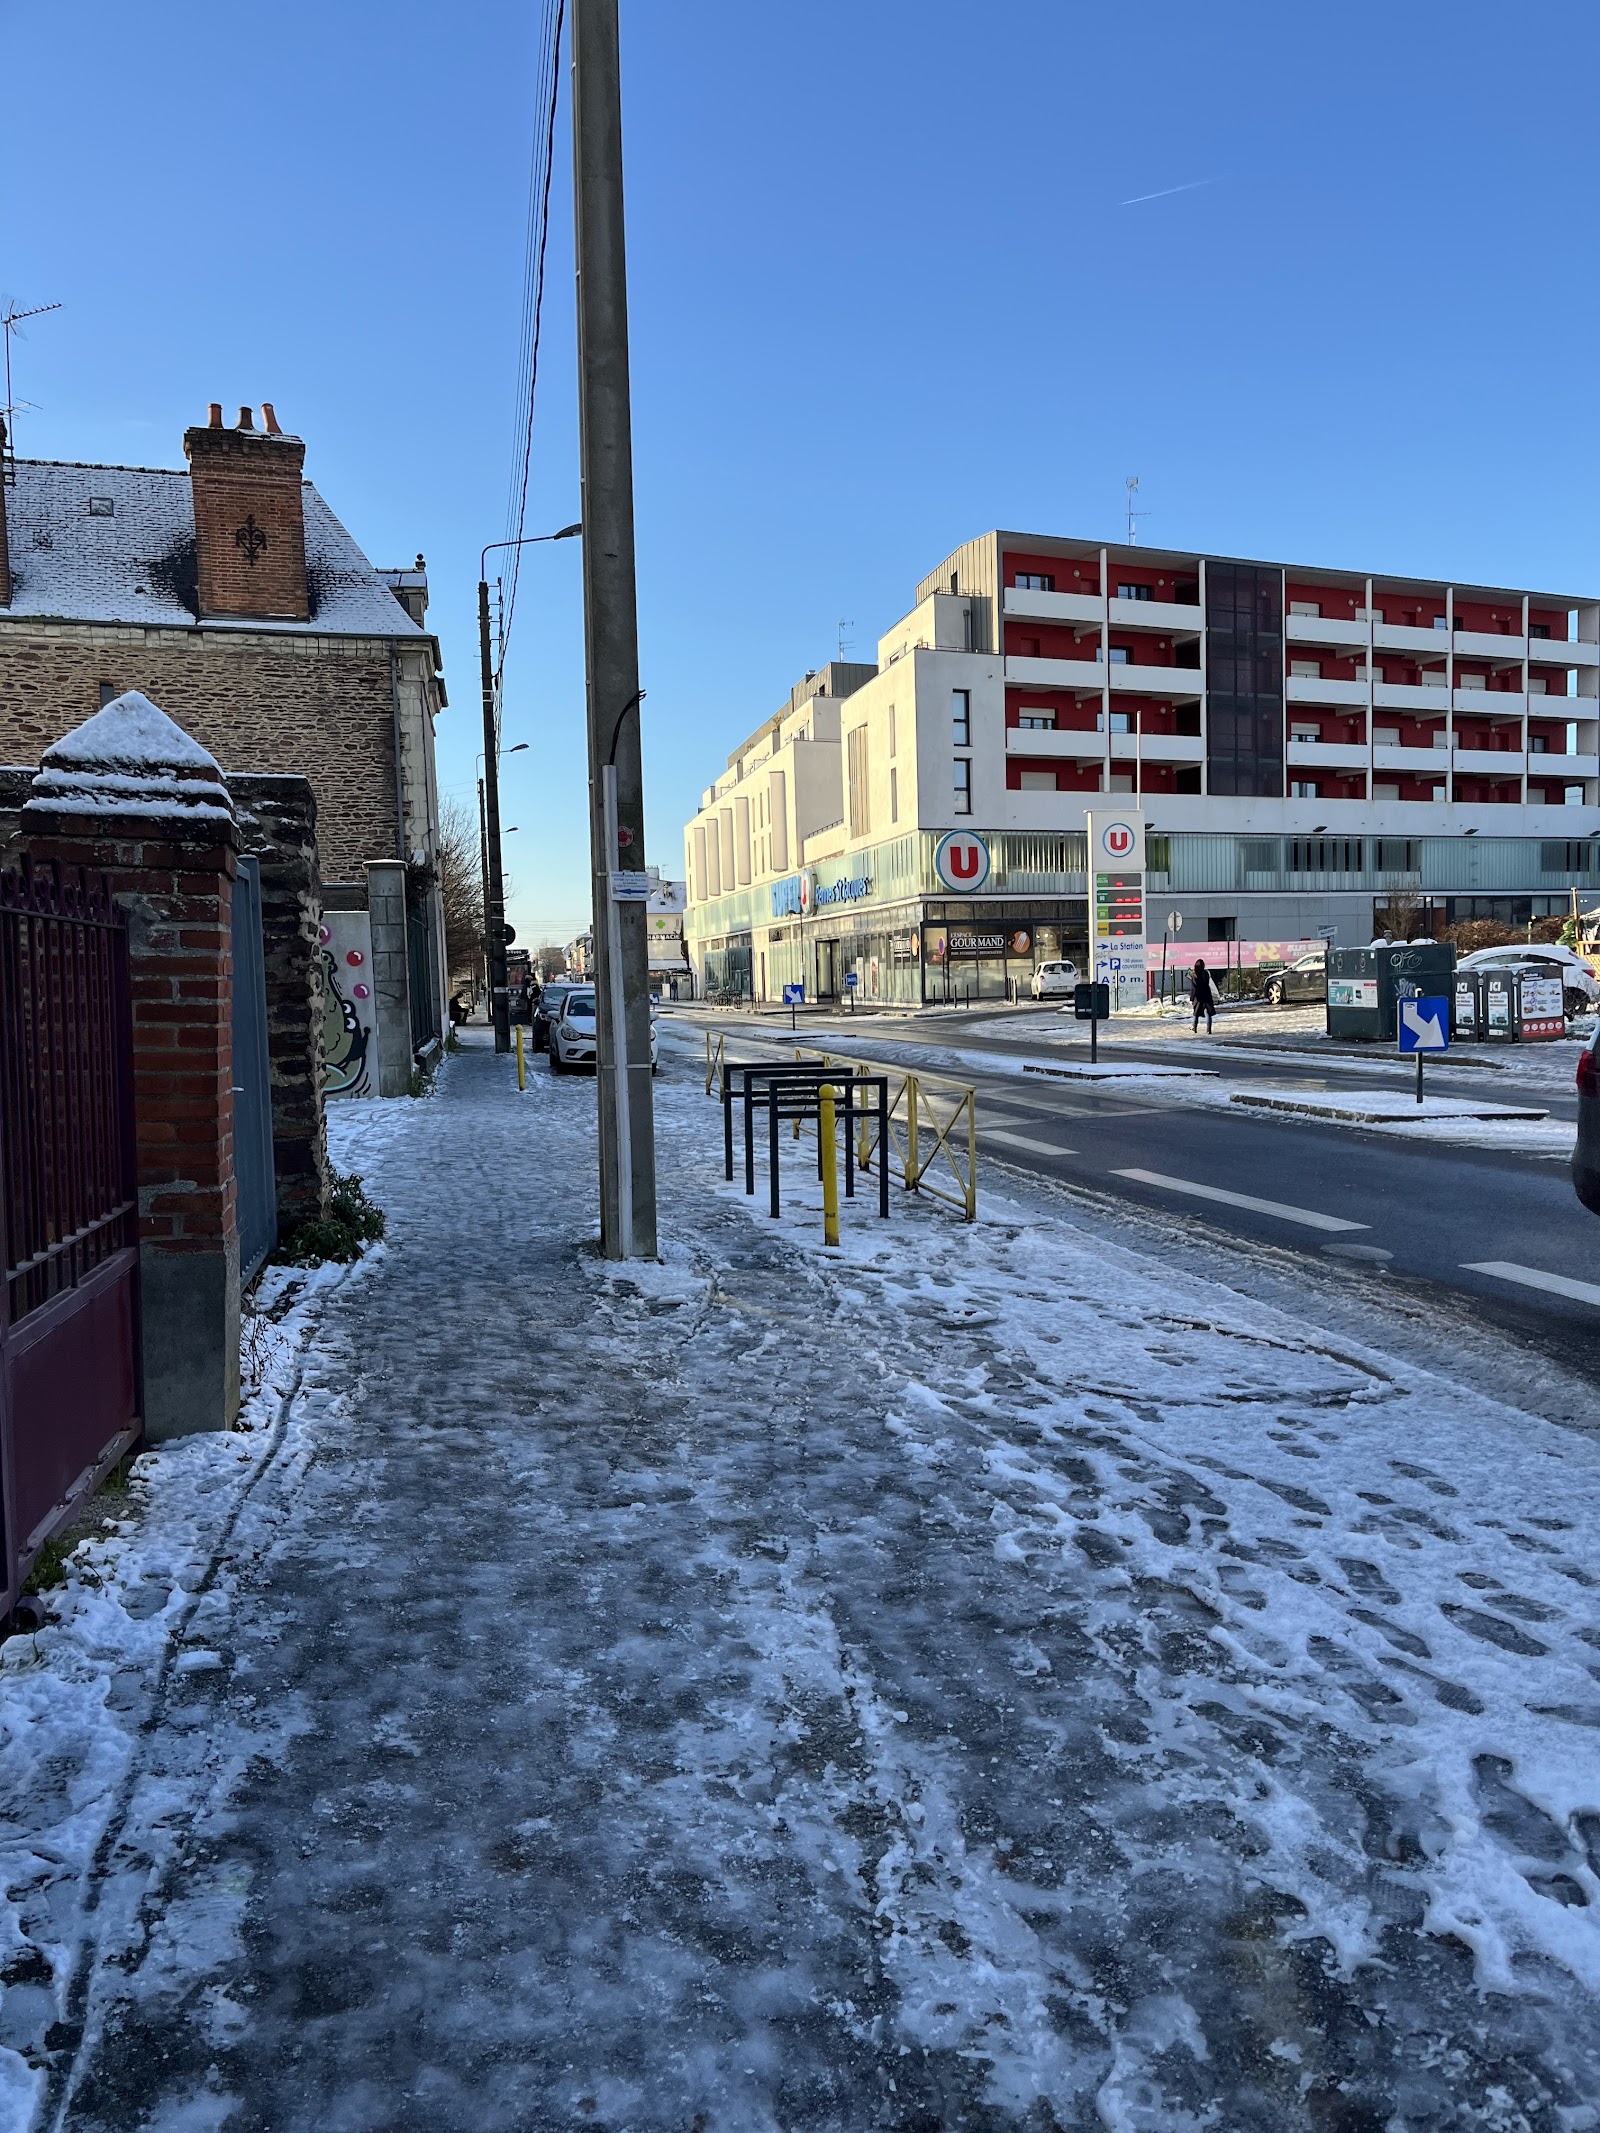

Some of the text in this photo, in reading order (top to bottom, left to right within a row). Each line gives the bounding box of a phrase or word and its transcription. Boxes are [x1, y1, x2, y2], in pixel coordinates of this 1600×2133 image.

[1110, 832, 1128, 851] U
[950, 847, 979, 878] U
[771, 875, 801, 917] SUPER
[815, 884, 836, 906] Rennes
[950, 937, 1004, 947] GOURMAND
[1120, 942, 1143, 950] Station
[1111, 959, 1119, 970] P
[1102, 976, 1110, 984] A
[1457, 982, 1468, 992] ICI
[1489, 981, 1501, 991] ICI
